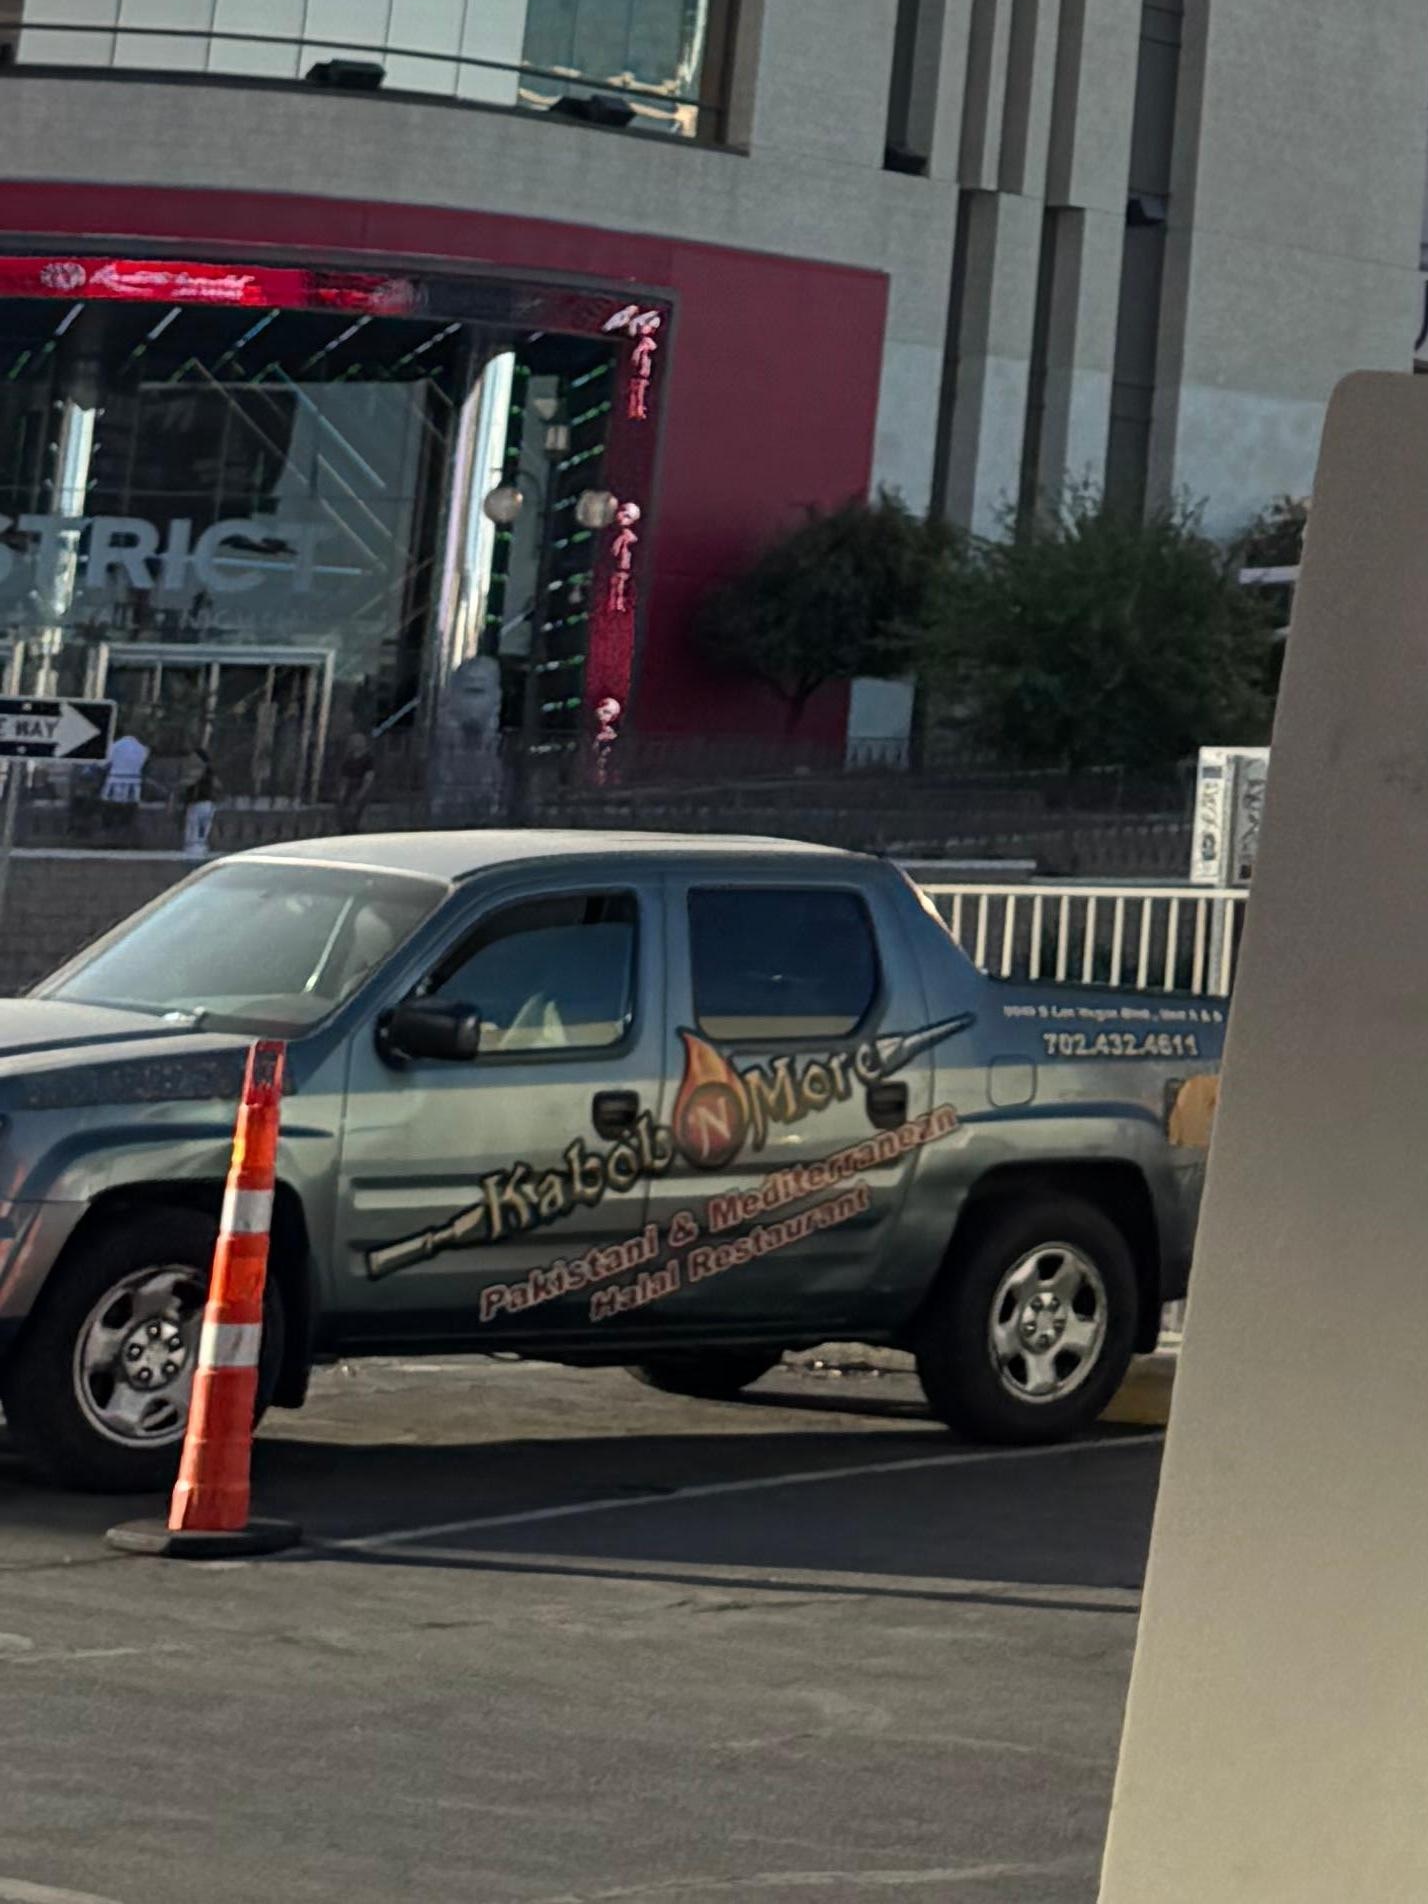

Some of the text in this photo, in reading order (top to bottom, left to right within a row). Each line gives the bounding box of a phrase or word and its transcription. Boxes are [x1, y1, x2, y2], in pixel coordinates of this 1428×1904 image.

[0, 512, 330, 594] TRICT
[15, 719, 60, 739] WAY
[742, 1042, 881, 1150] More
[480, 1103, 959, 1322] Pakistani & Mediterranean
[589, 1182, 872, 1323] Halal Restaurant
